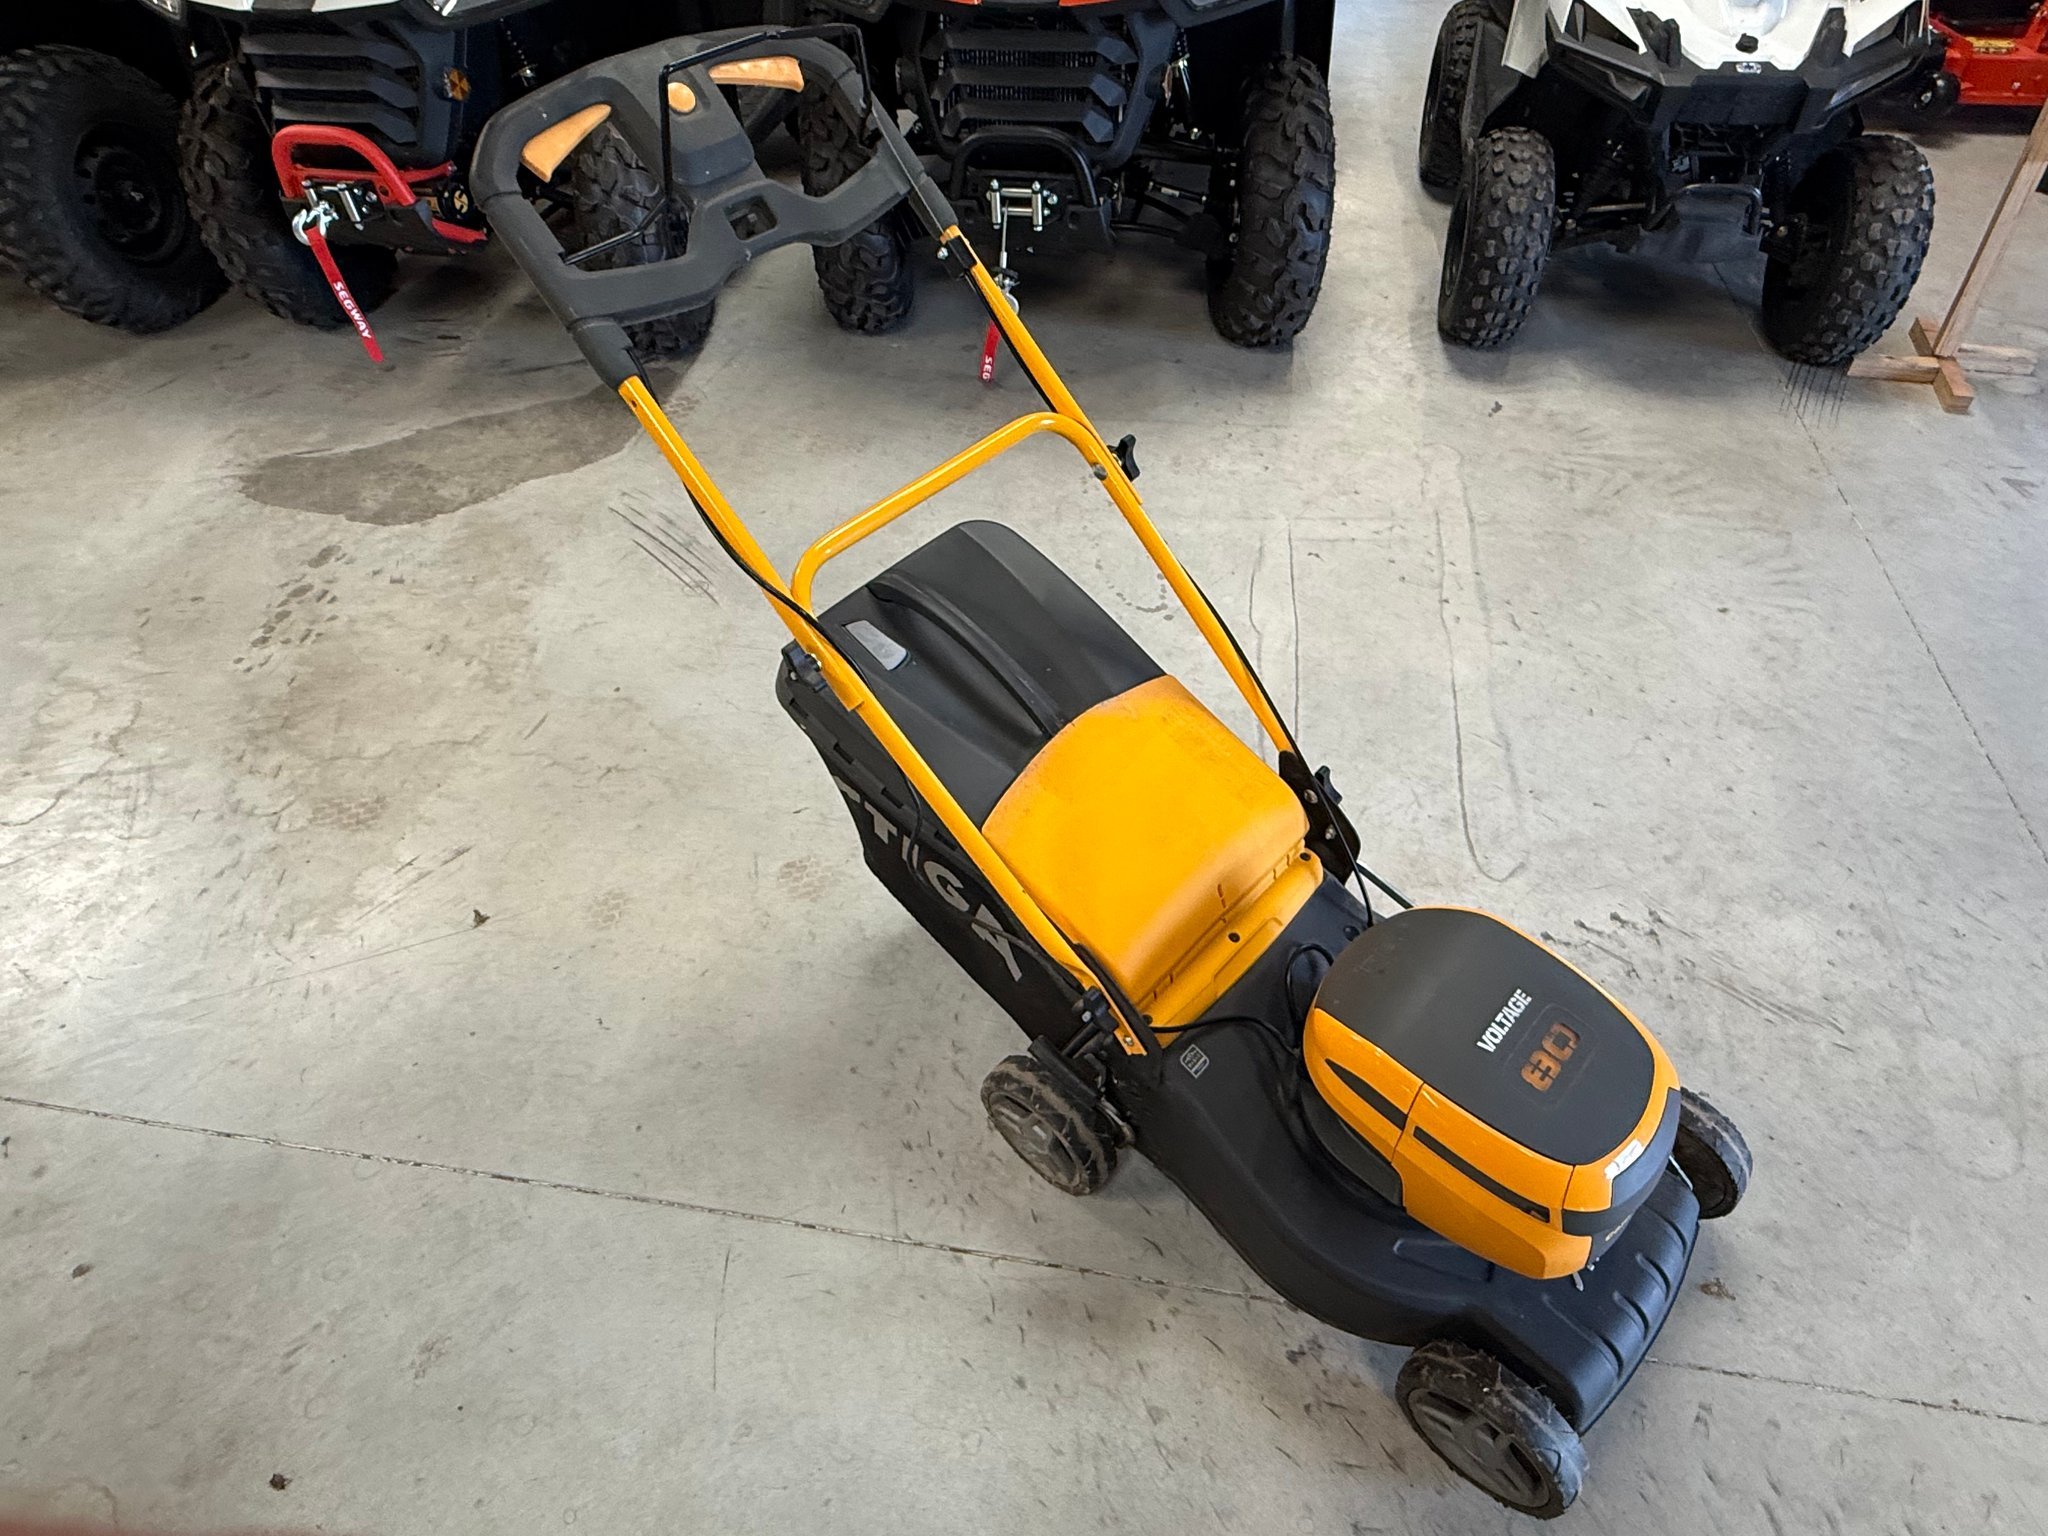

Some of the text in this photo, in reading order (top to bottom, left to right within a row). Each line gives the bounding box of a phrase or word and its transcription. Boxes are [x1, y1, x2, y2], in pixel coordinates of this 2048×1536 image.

[333, 281, 372, 339] SEGWAY
[833, 775, 1022, 982] TIGA
[1476, 988, 1533, 1053] VOLTAGE
